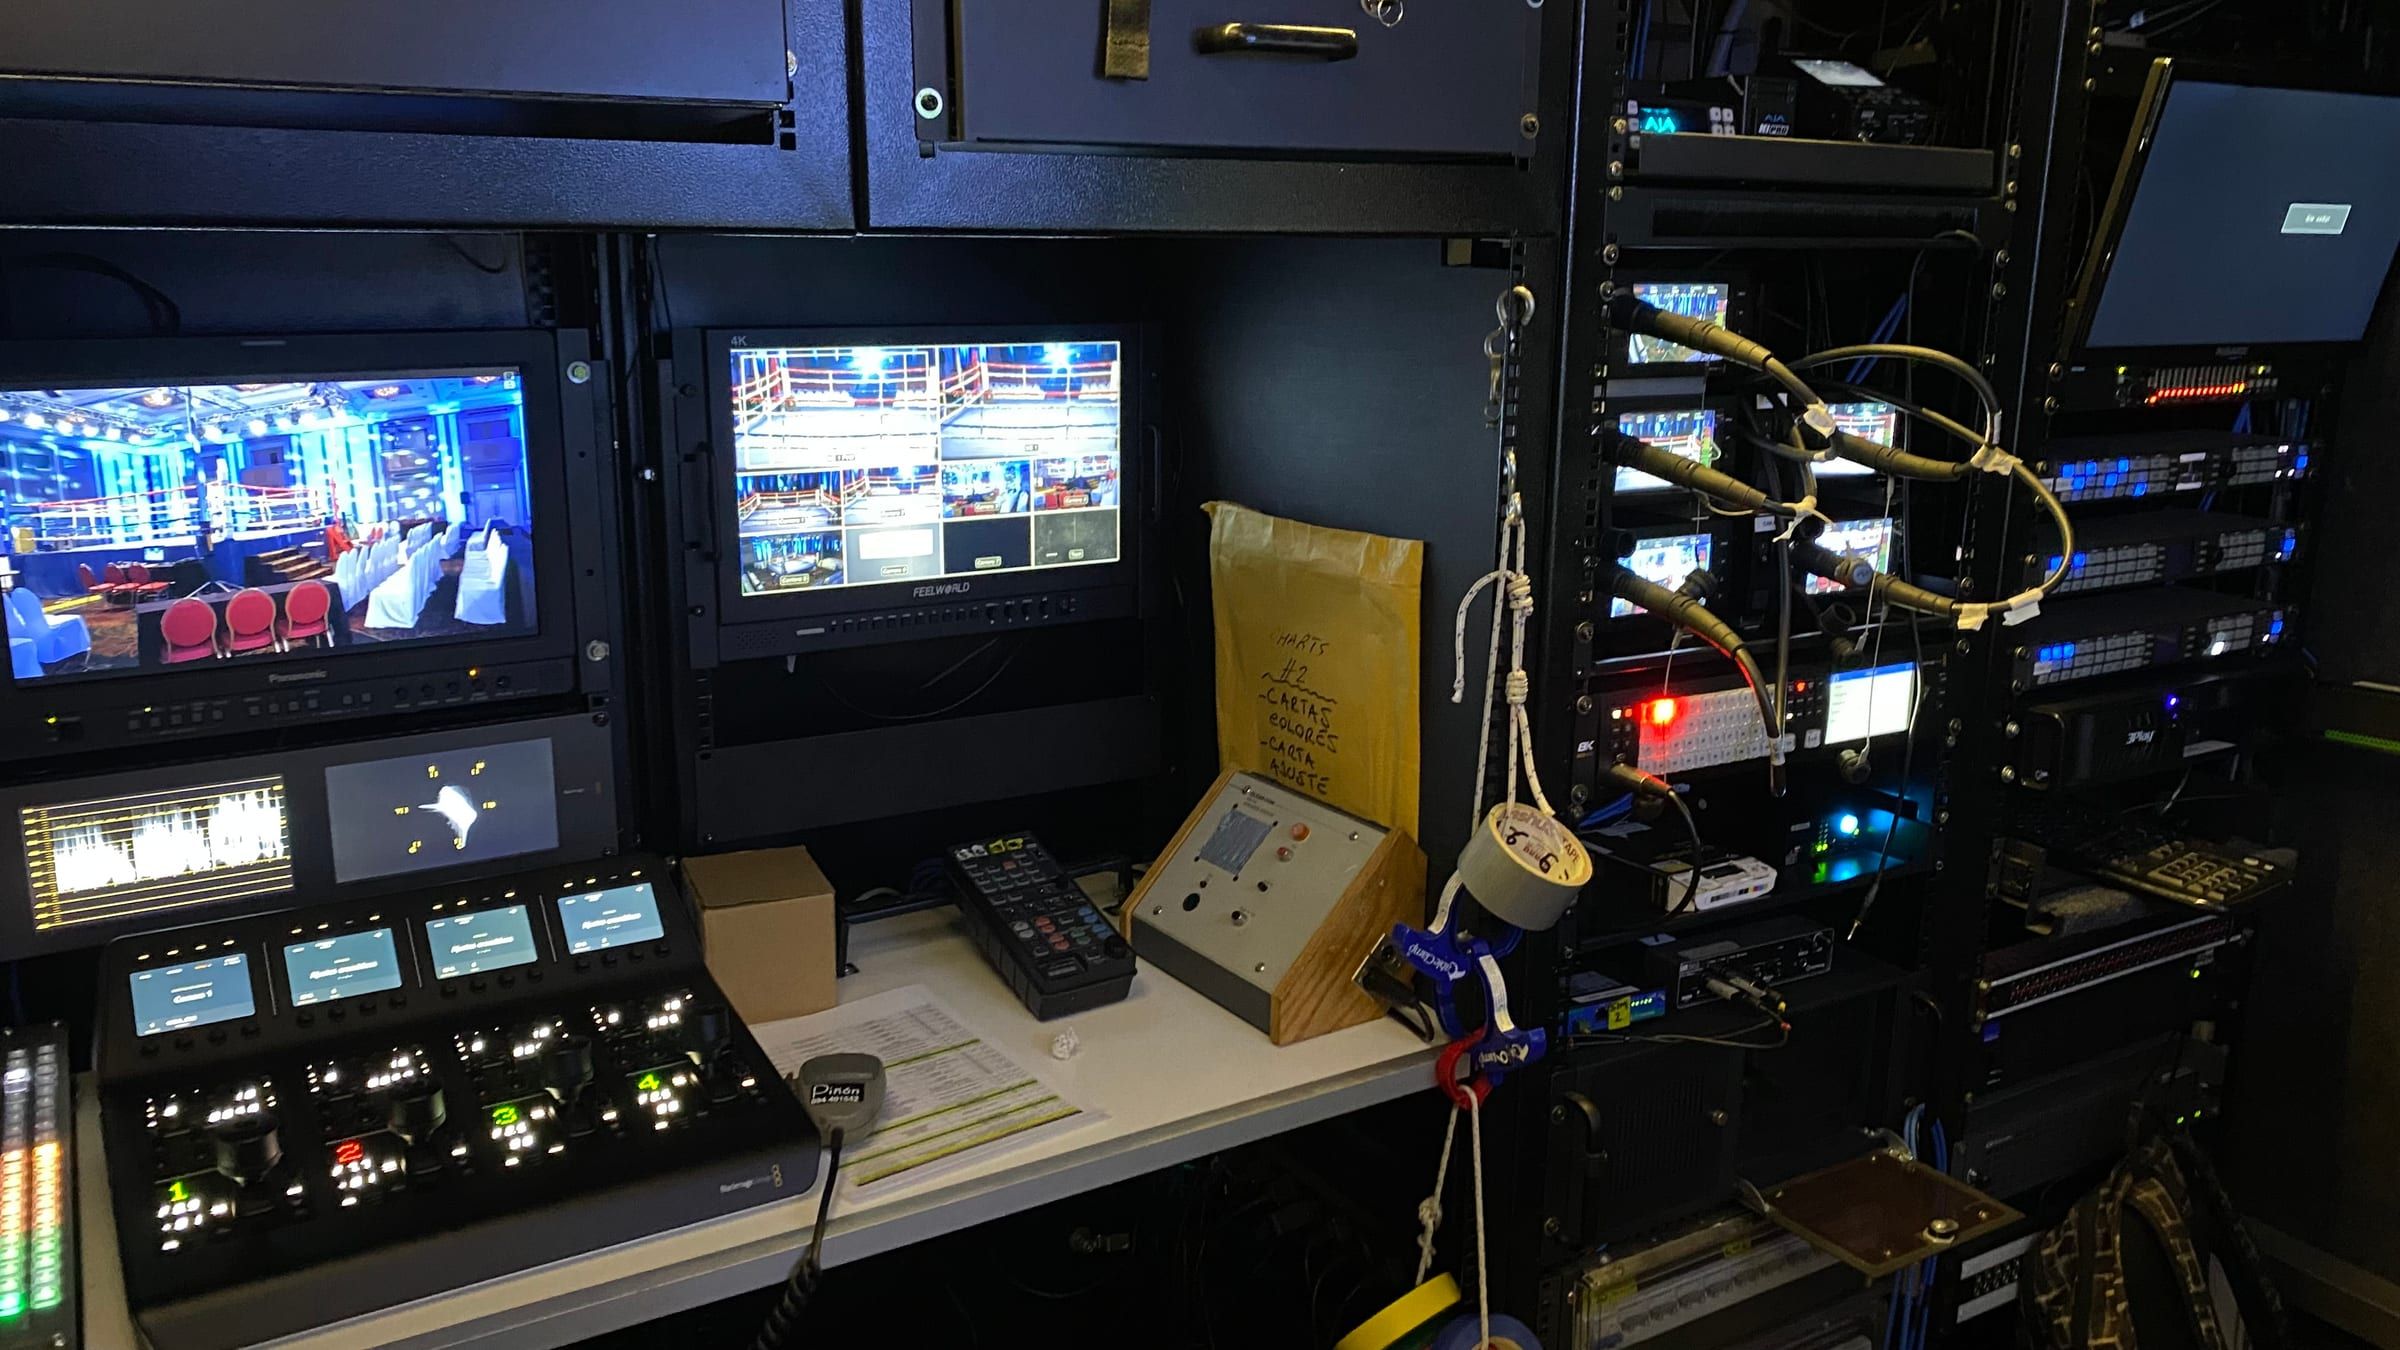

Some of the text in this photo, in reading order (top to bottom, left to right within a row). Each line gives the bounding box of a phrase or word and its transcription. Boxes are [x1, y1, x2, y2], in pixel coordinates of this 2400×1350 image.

[730, 335, 747, 346] 4K
[913, 581, 970, 598] FEELWORLD
[1280, 657, 1308, 683] #2
[638, 1073, 660, 1090] 4
[492, 1105, 518, 1125] 3
[336, 1141, 363, 1163] 2
[168, 1180, 189, 1202] 1
